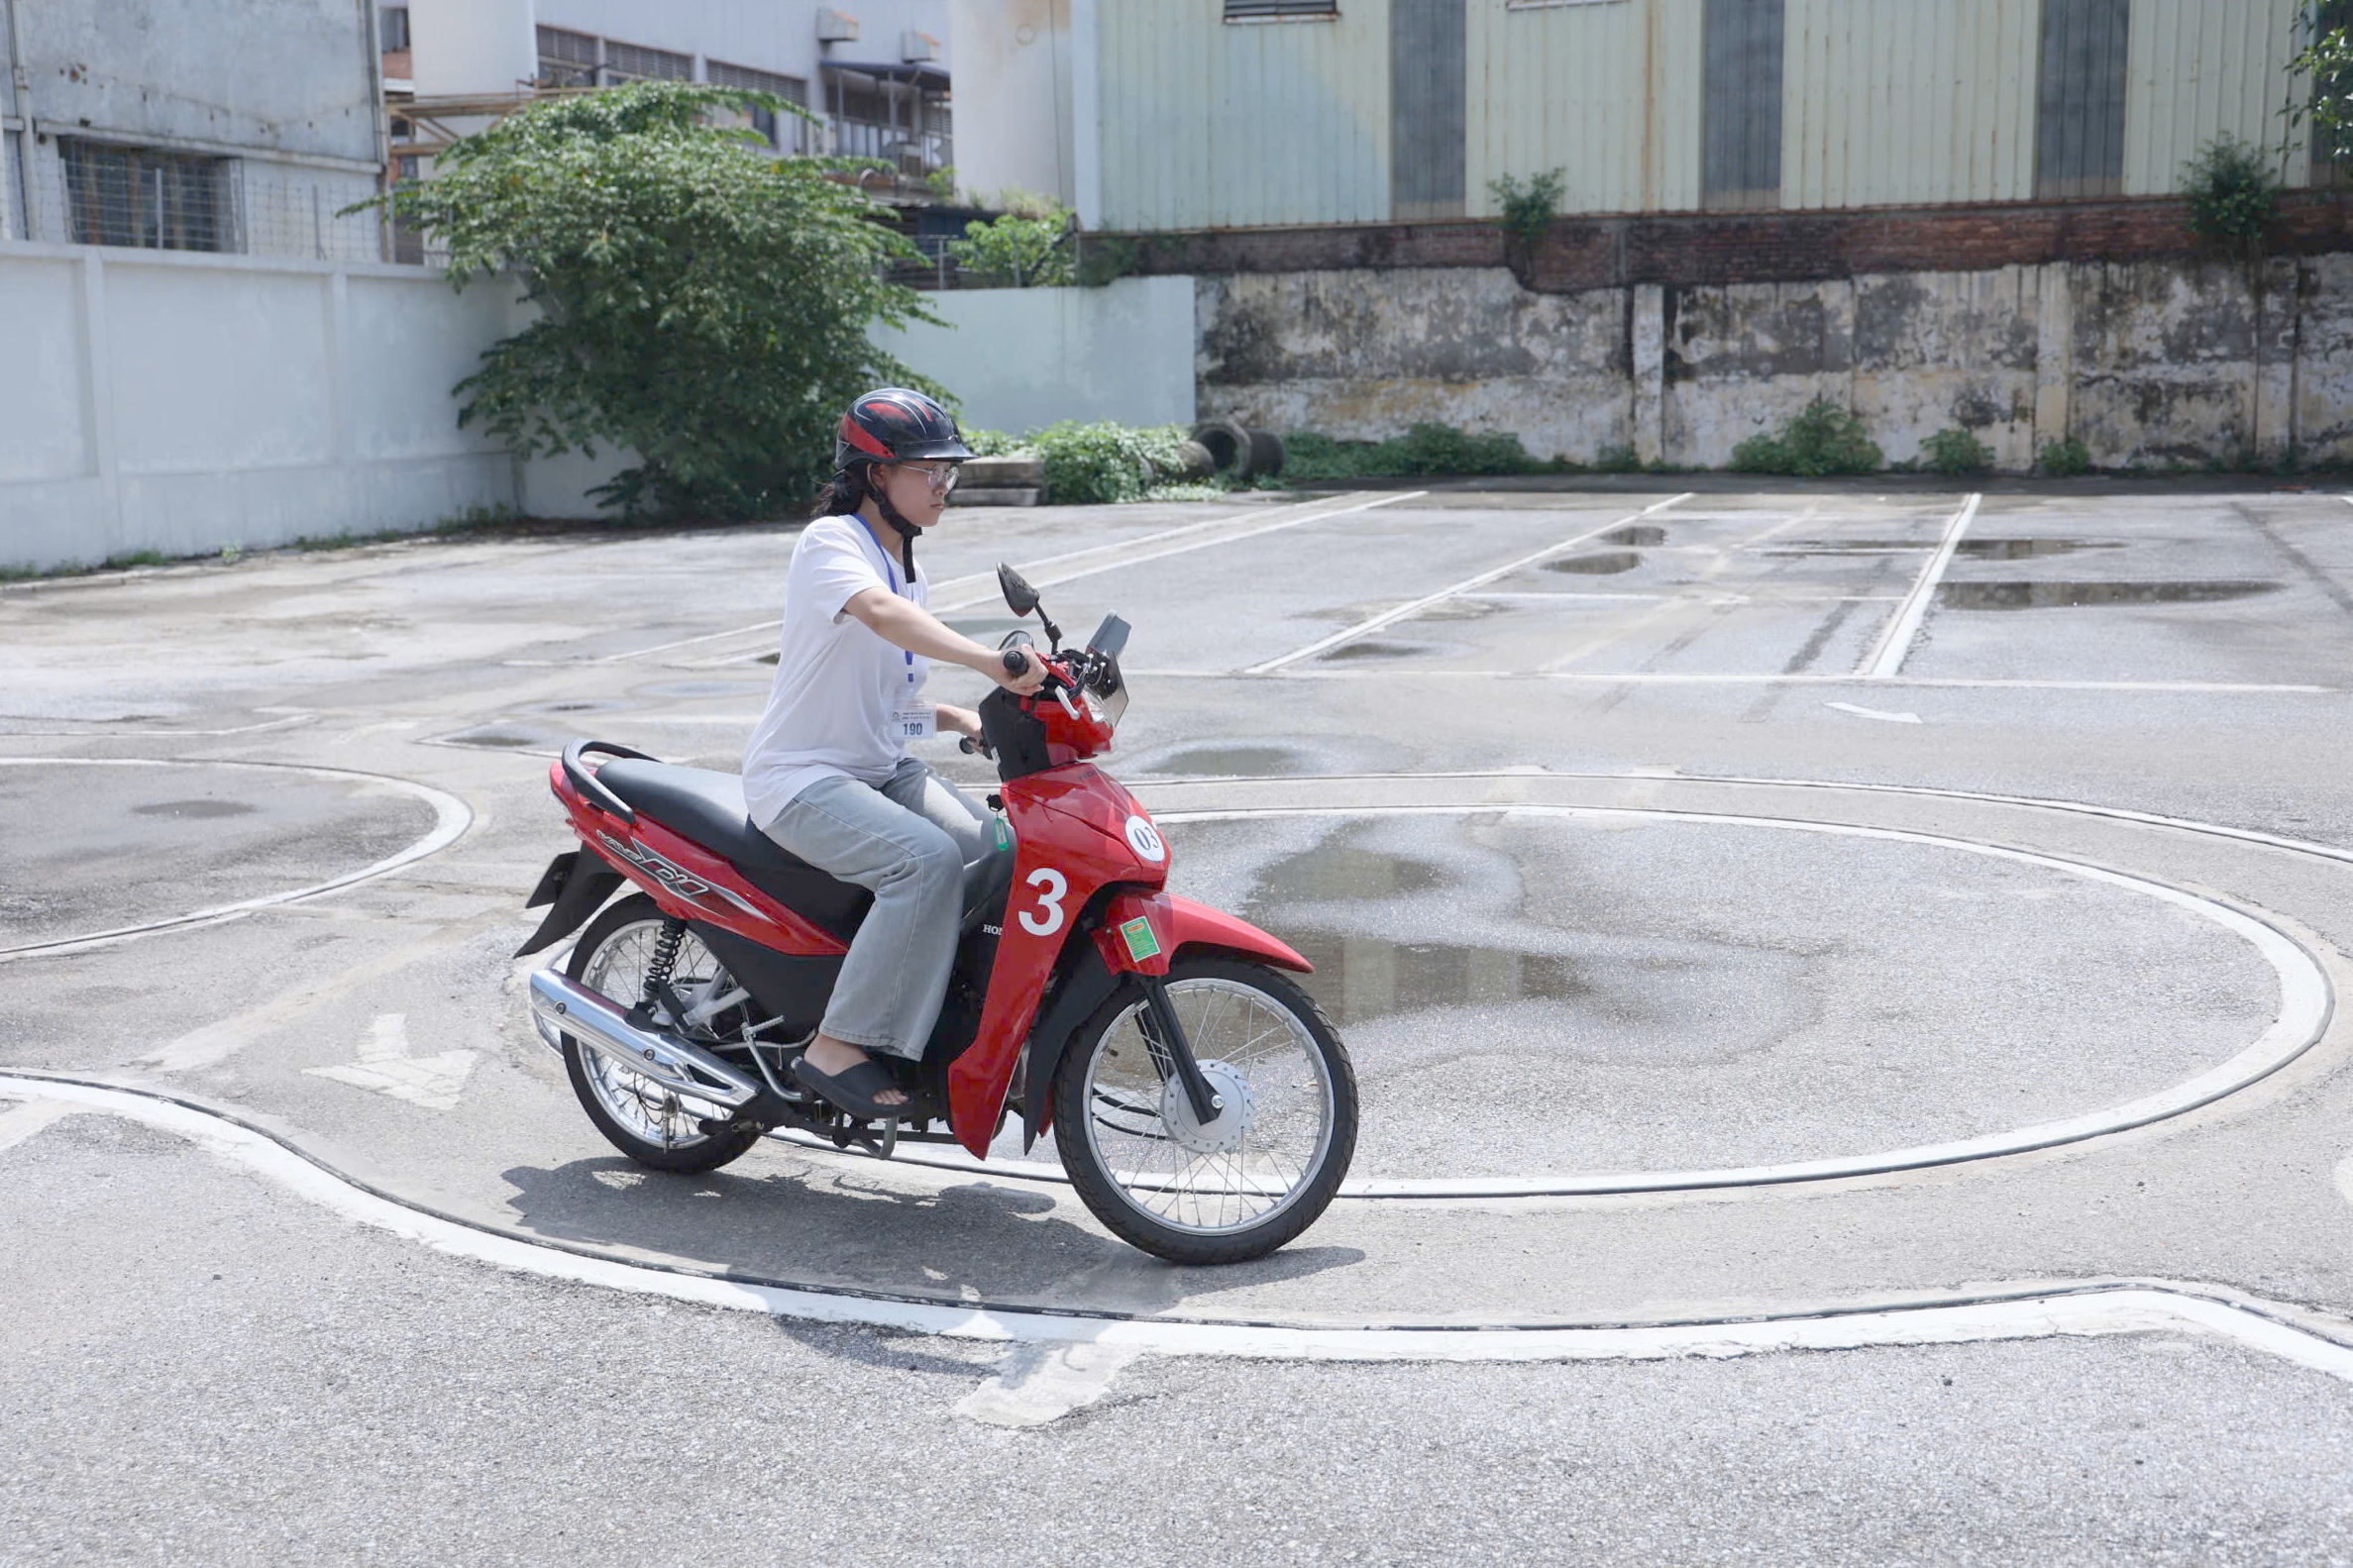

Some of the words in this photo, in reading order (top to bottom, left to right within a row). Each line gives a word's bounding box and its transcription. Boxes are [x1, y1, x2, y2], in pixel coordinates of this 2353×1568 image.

[903, 722, 923, 736] 190
[1133, 826, 1159, 851] 03
[1017, 868, 1068, 936] 3
